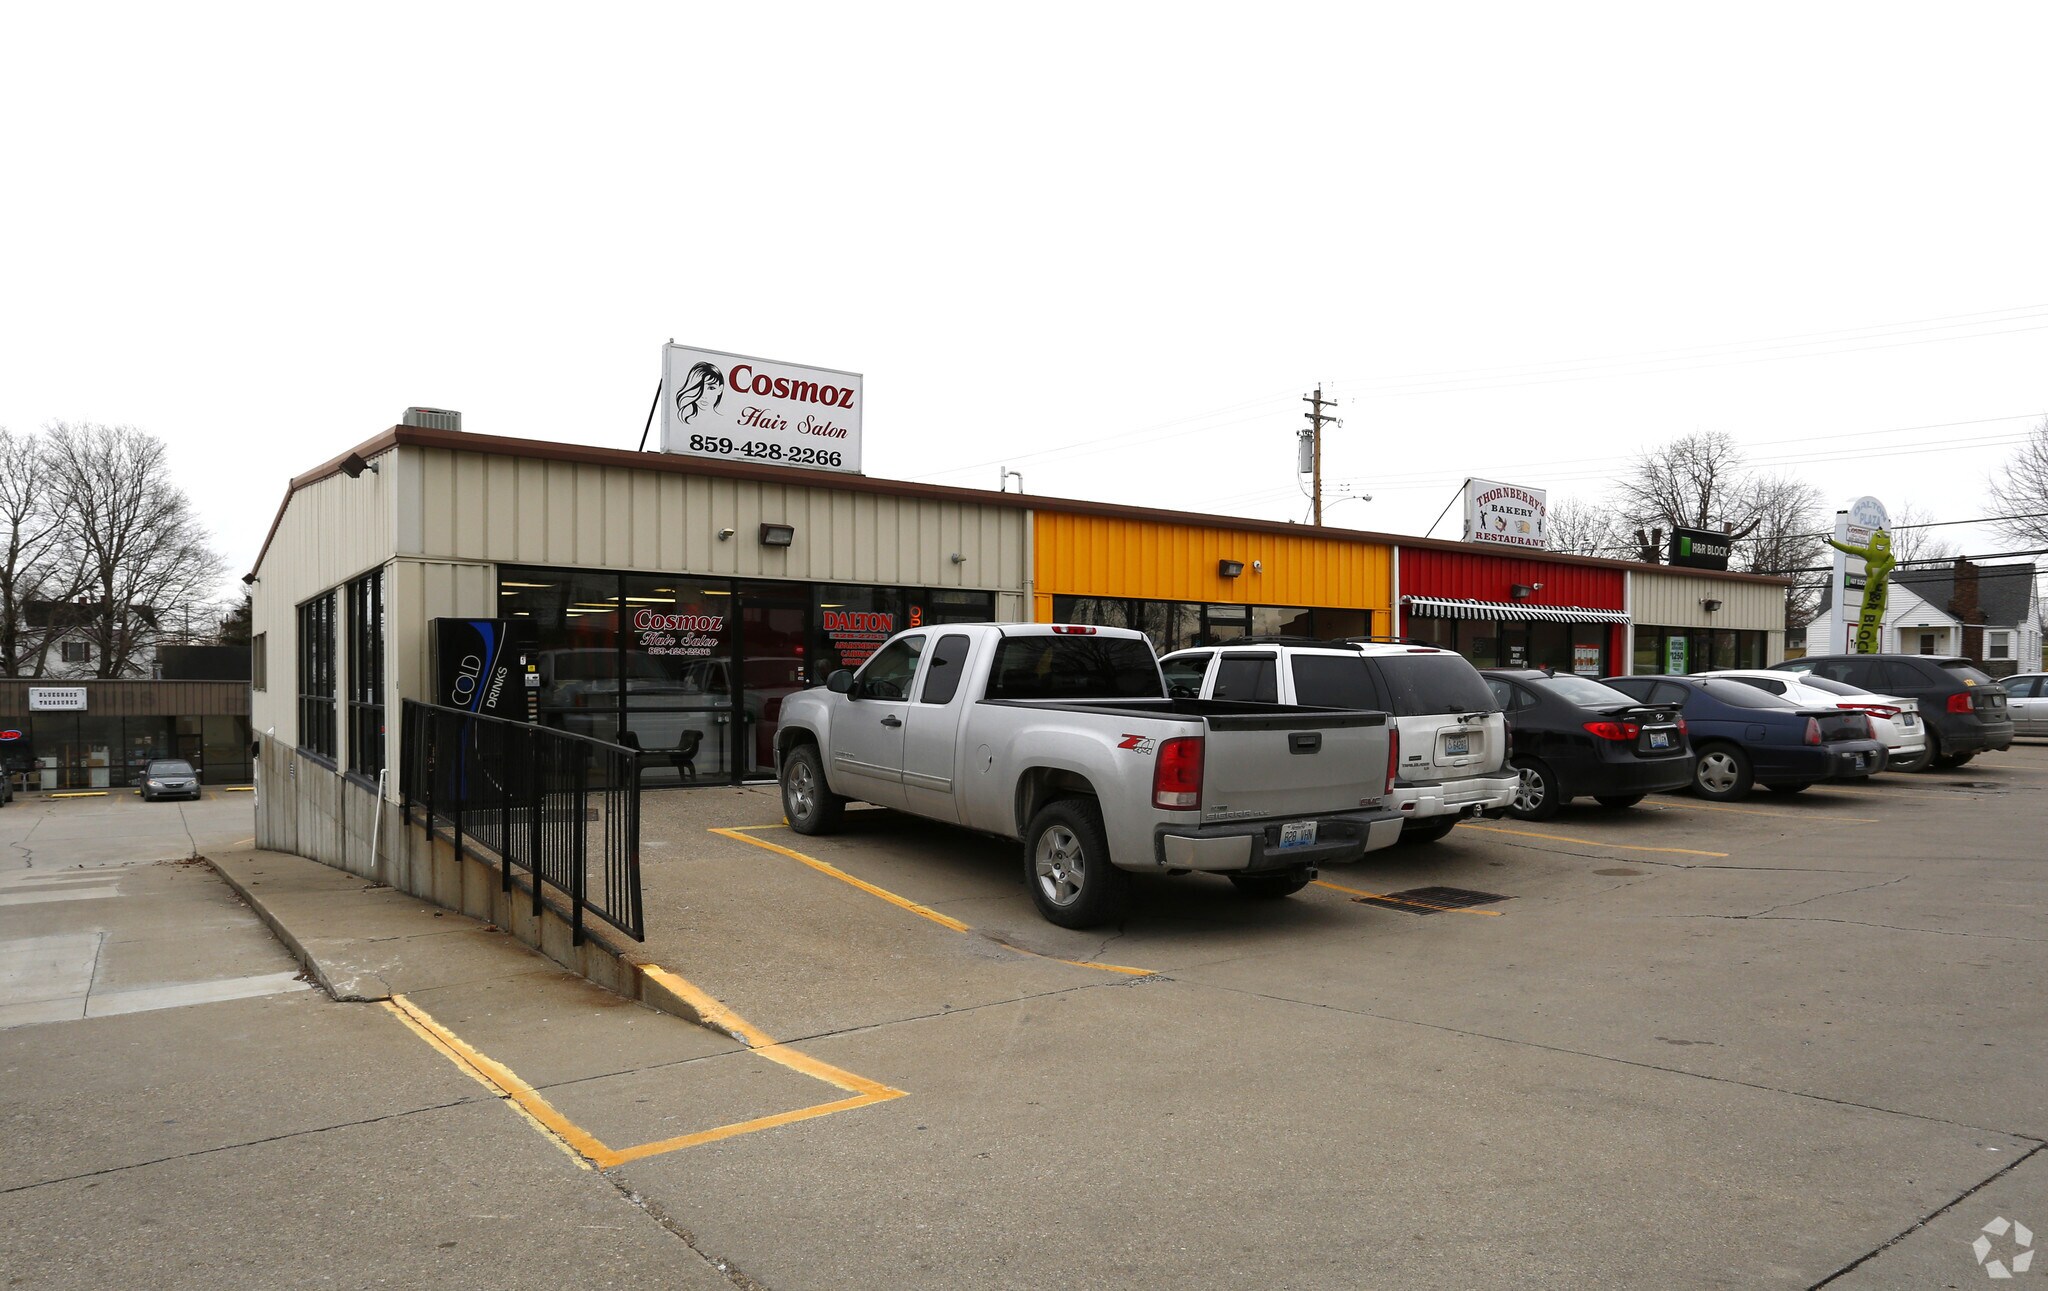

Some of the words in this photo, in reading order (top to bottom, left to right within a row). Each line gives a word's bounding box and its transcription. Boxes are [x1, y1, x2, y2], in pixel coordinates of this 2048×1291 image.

[729, 364, 855, 409] Cosmoz
[737, 406, 788, 431] Hair
[797, 415, 848, 439] Salon
[690, 434, 842, 467] 859-428-2266
[1476, 487, 1546, 517] THORNBERRY'S
[1491, 504, 1533, 517] BAKERY
[1854, 501, 1887, 522] DALTON
[1859, 512, 1881, 526] PLAZA
[1475, 531, 1546, 547] RESTAURANT
[1692, 542, 1707, 554] H&R
[1707, 545, 1728, 557] BLOCK
[634, 609, 723, 631] Cosmoz
[823, 611, 893, 632] DALTON
[640, 631, 676, 646] Hair
[680, 632, 719, 647] Salon
[840, 650, 875, 658] CARWAS
[451, 655, 481, 705] COLD
[486, 666, 508, 708] DRINKS
[1206, 809, 1251, 821] SIERRA
